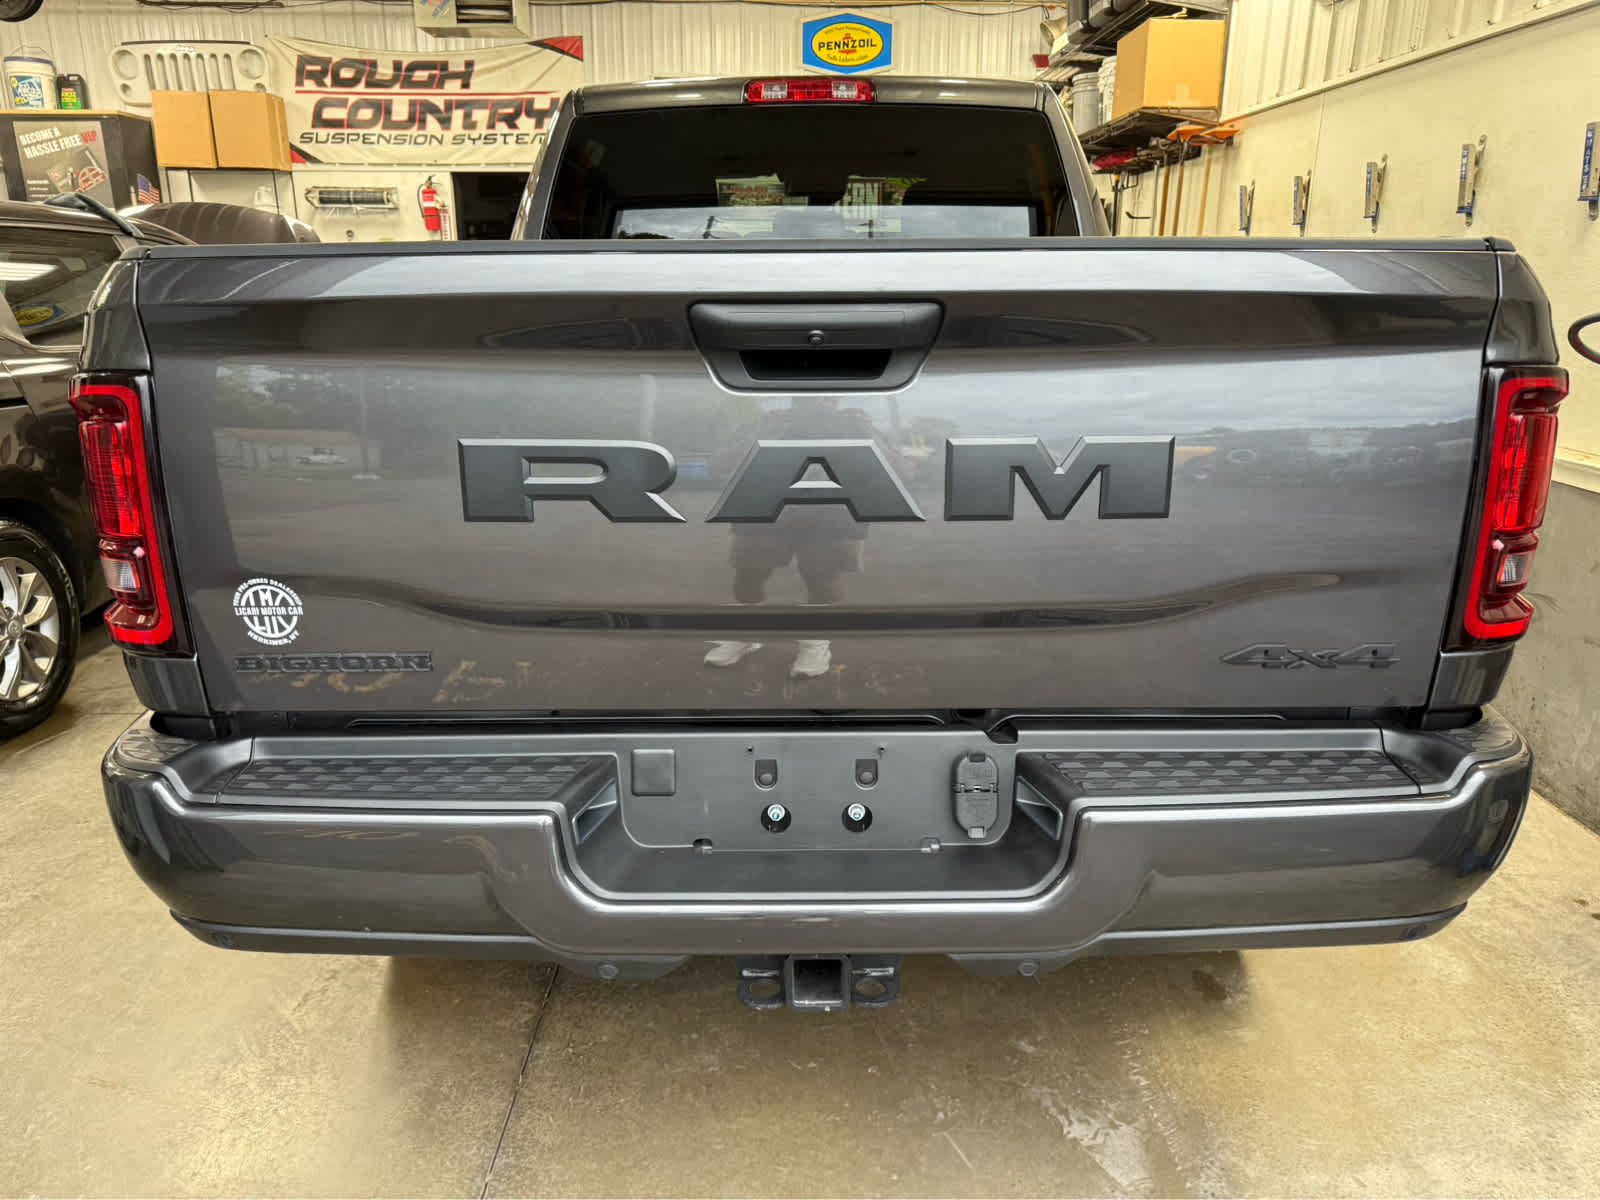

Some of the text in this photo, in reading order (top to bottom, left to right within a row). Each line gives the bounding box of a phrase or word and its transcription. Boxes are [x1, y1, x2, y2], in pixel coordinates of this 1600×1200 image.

[818, 38, 877, 51] PENNZOIL
[295, 54, 475, 90] ROUGH
[311, 97, 560, 131] COUNTRY
[19, 128, 54, 146] BECOME
[23, 141, 61, 160] HASSLE
[59, 134, 82, 151] FREE
[299, 131, 444, 145] SUSPENSION
[457, 436, 1176, 523] RAM
[287, 606, 304, 616] CAR
[234, 652, 434, 673] BIGHORN
